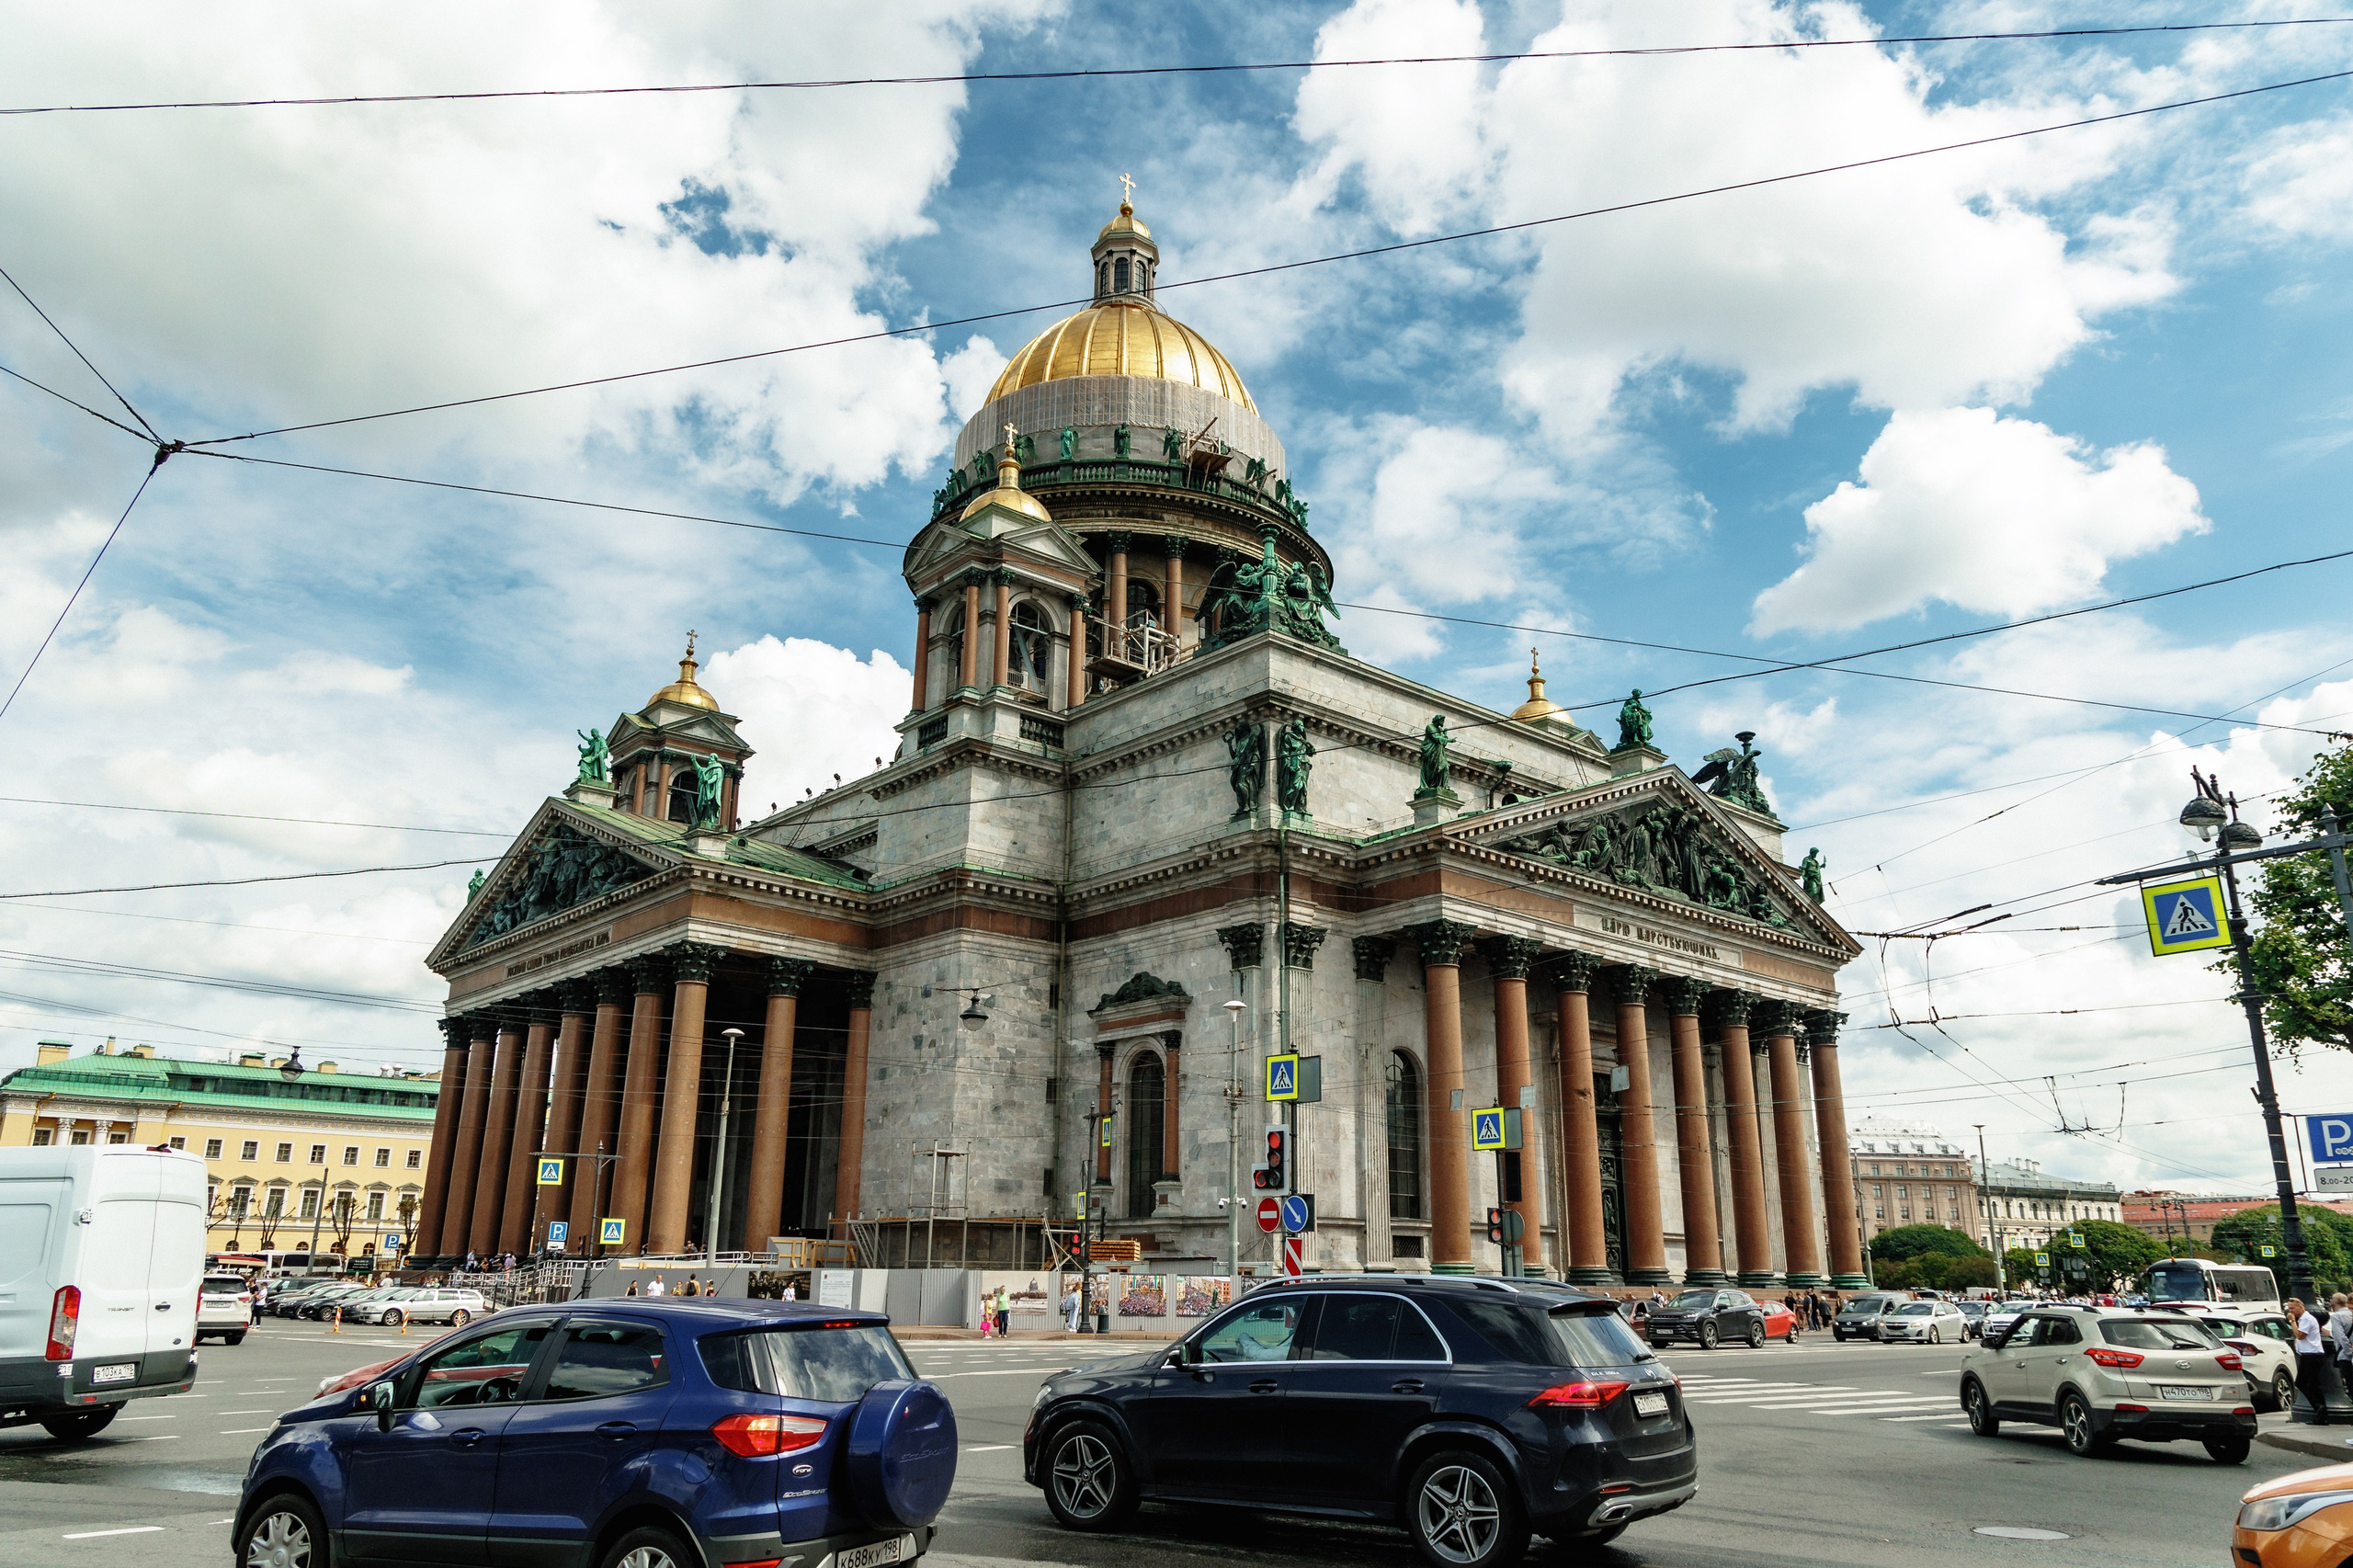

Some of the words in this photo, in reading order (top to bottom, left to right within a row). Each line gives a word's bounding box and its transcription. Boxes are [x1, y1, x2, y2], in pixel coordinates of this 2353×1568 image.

[2321, 1119, 2351, 1157] P
[552, 1223, 563, 1239] P
[388, 1235, 398, 1247] P
[882, 1540, 898, 1556] 198
